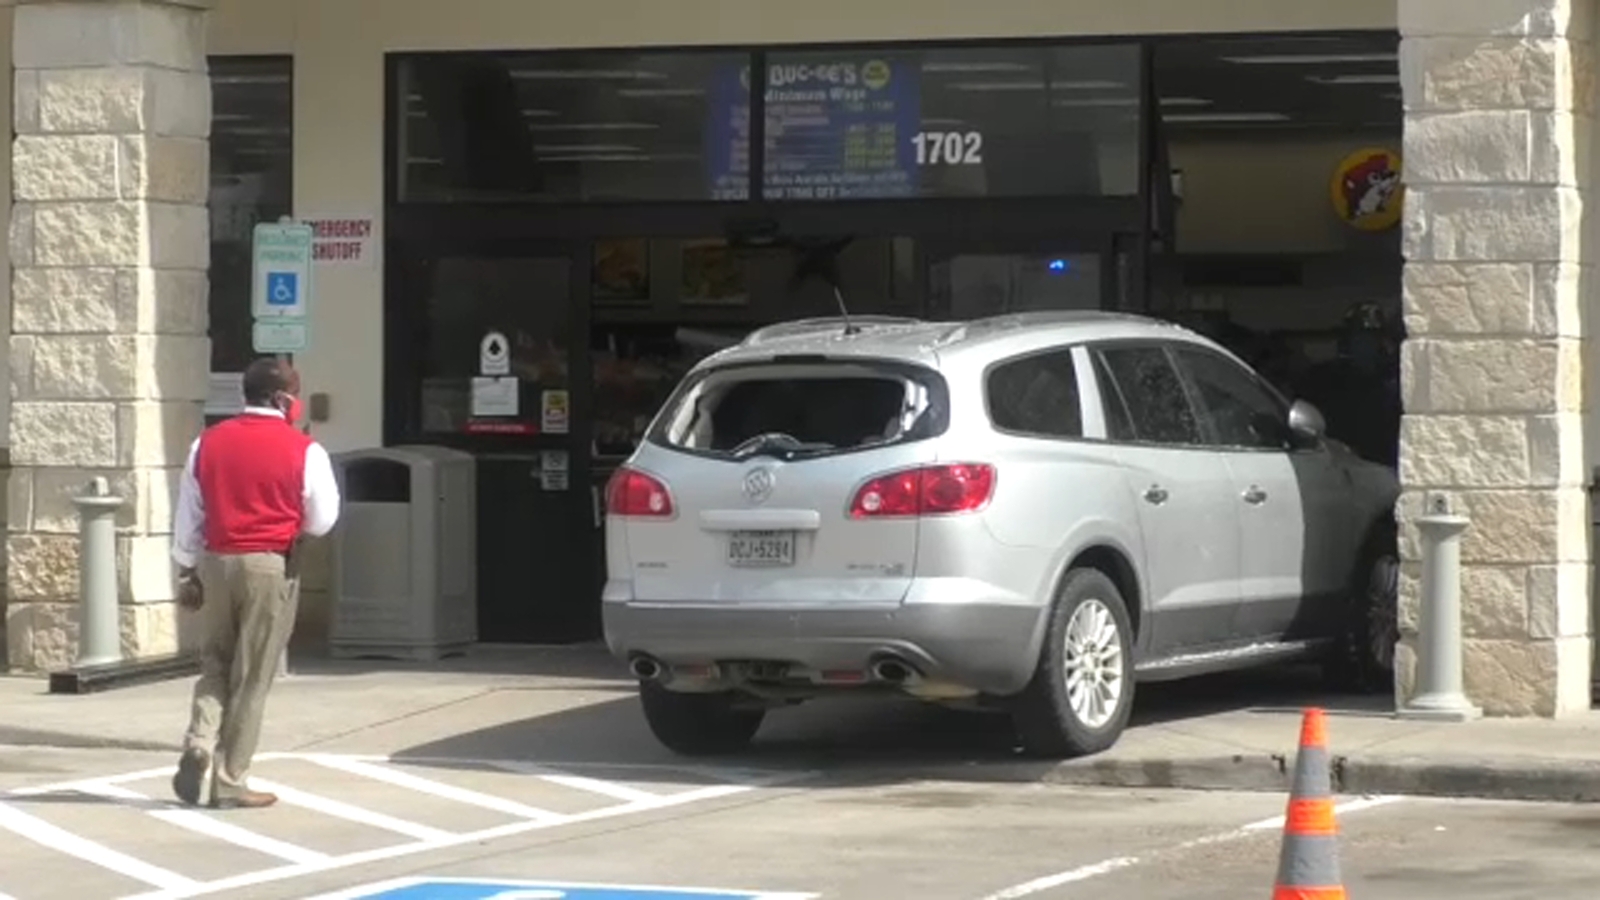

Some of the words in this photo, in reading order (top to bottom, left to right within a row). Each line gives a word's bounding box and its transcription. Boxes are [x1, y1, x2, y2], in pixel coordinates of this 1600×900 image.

[911, 131, 982, 164] 1702
[302, 219, 371, 238] MERGENCY
[311, 242, 362, 260] SHUTOFF
